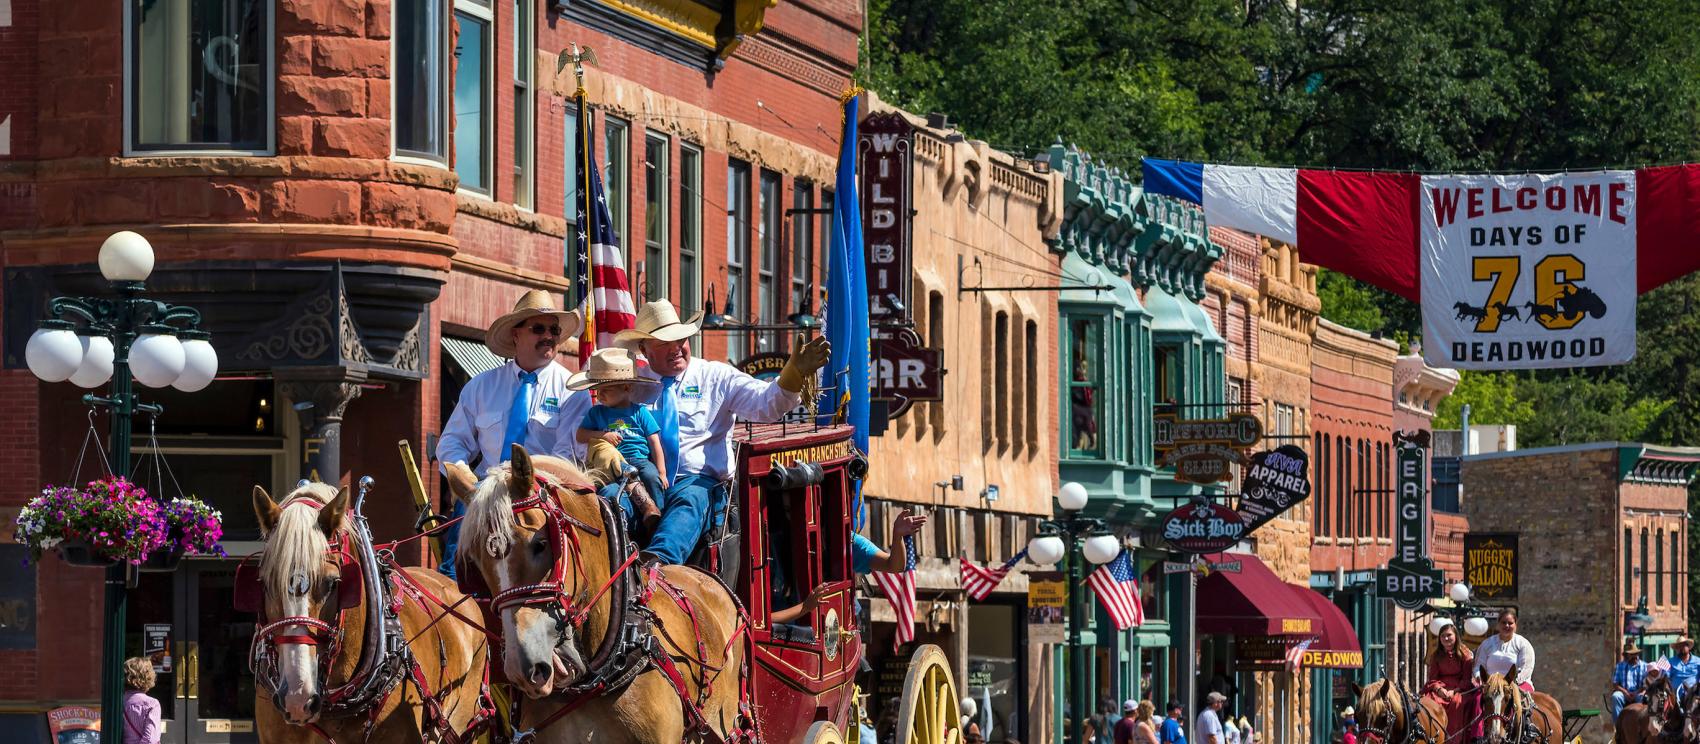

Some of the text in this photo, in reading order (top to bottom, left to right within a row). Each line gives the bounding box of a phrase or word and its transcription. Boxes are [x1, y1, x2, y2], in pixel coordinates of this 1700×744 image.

[1431, 182, 1627, 228] WELCOME
[871, 133, 898, 340] WILD BILL
[1470, 224, 1587, 247] DAYS OF
[1472, 253, 1586, 333] 76
[1451, 337, 1606, 363] DEADWOOD
[870, 358, 927, 389] AR
[1152, 417, 1256, 445] HISTORIC
[769, 448, 809, 468] SUTTON
[811, 444, 834, 463] RANCH
[1183, 460, 1224, 475] CLUB
[1250, 464, 1307, 495] APPAREL
[1402, 460, 1418, 563] EAGLE
[1164, 517, 1206, 540] Sick
[1205, 517, 1243, 540] Boy
[1468, 550, 1514, 570] NUGGET
[1386, 575, 1433, 593] BAR
[1468, 565, 1514, 587] SALOON
[1303, 650, 1363, 667] DEADWOOD
[50, 708, 81, 721] SHOCK
